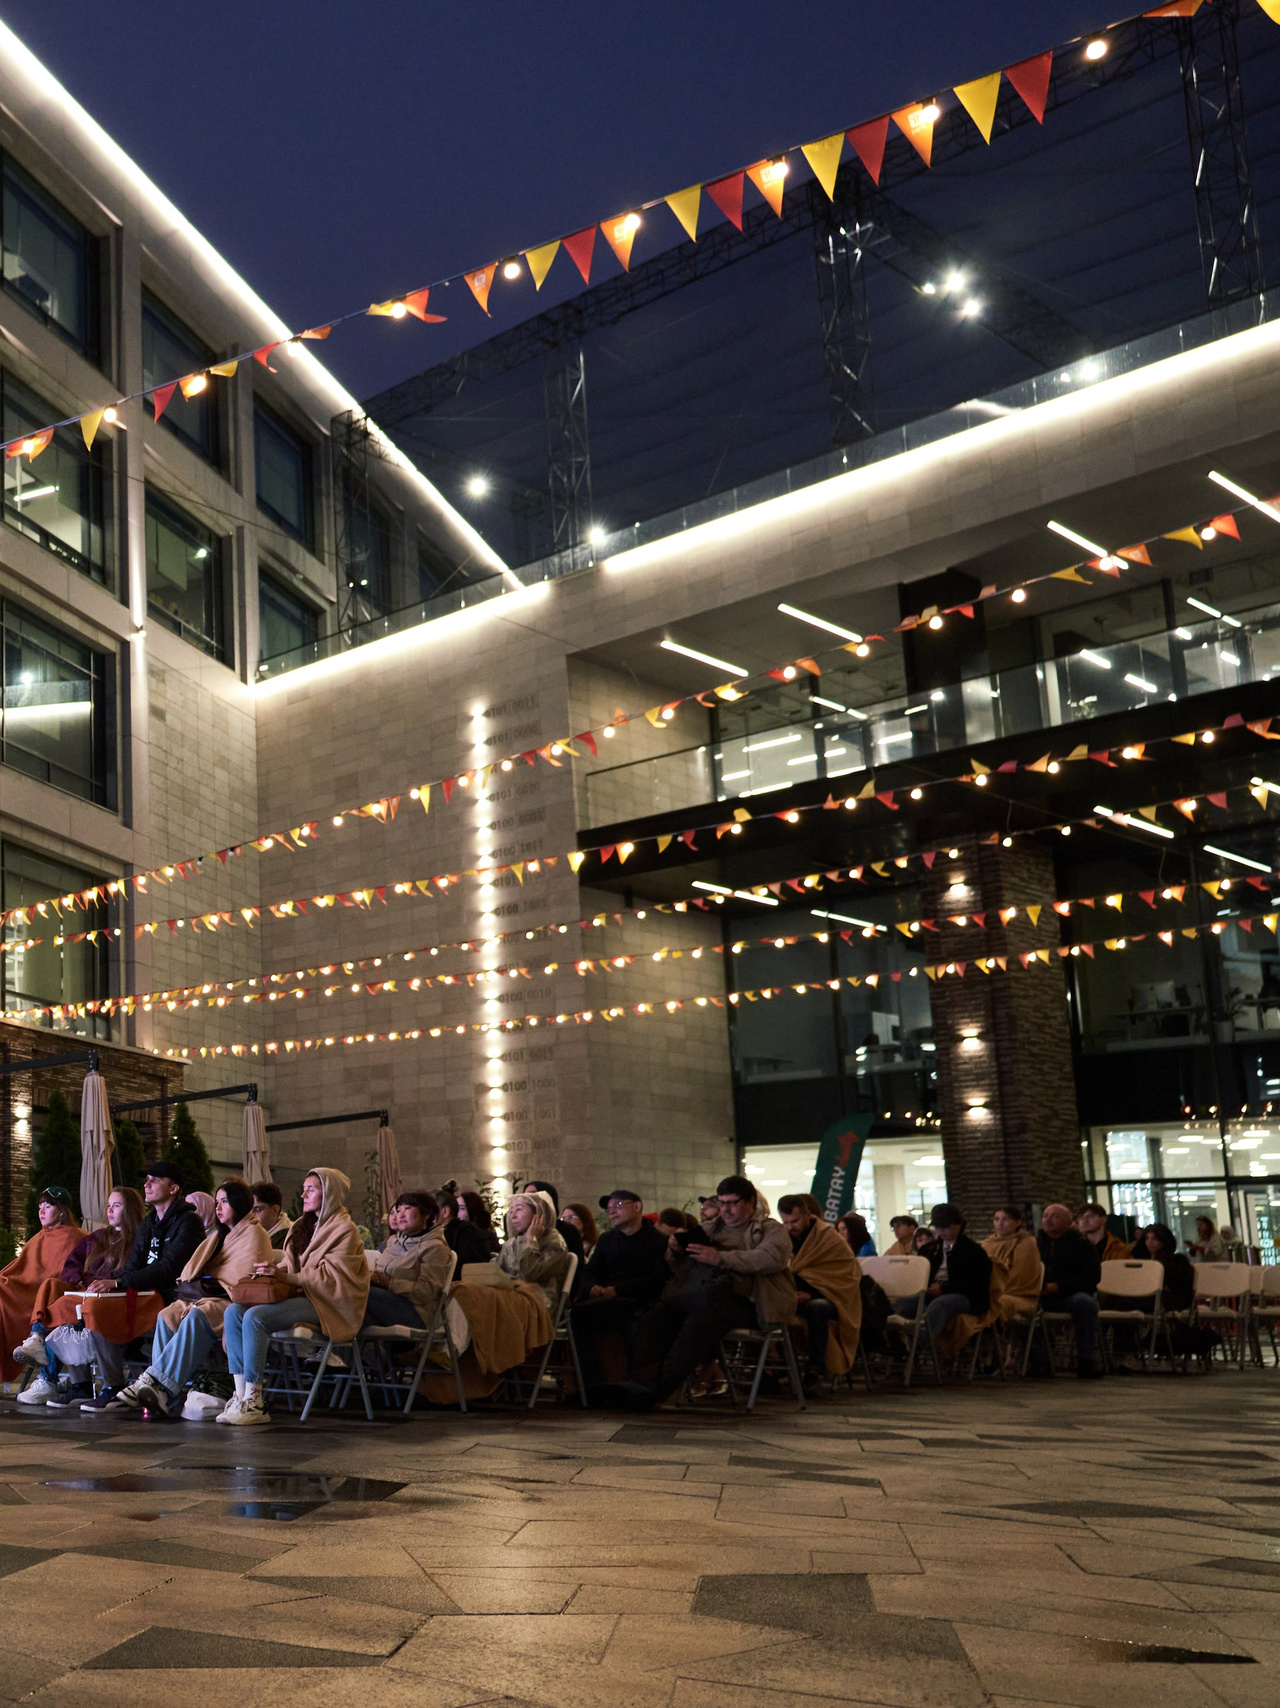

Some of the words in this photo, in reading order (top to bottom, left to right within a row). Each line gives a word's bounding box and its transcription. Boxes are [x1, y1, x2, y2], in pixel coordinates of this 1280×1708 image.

[499, 991, 523, 1004] 0100
[501, 1050, 524, 1062] 0101
[503, 1079, 527, 1092] 0100
[824, 1166, 846, 1227] BATAY
